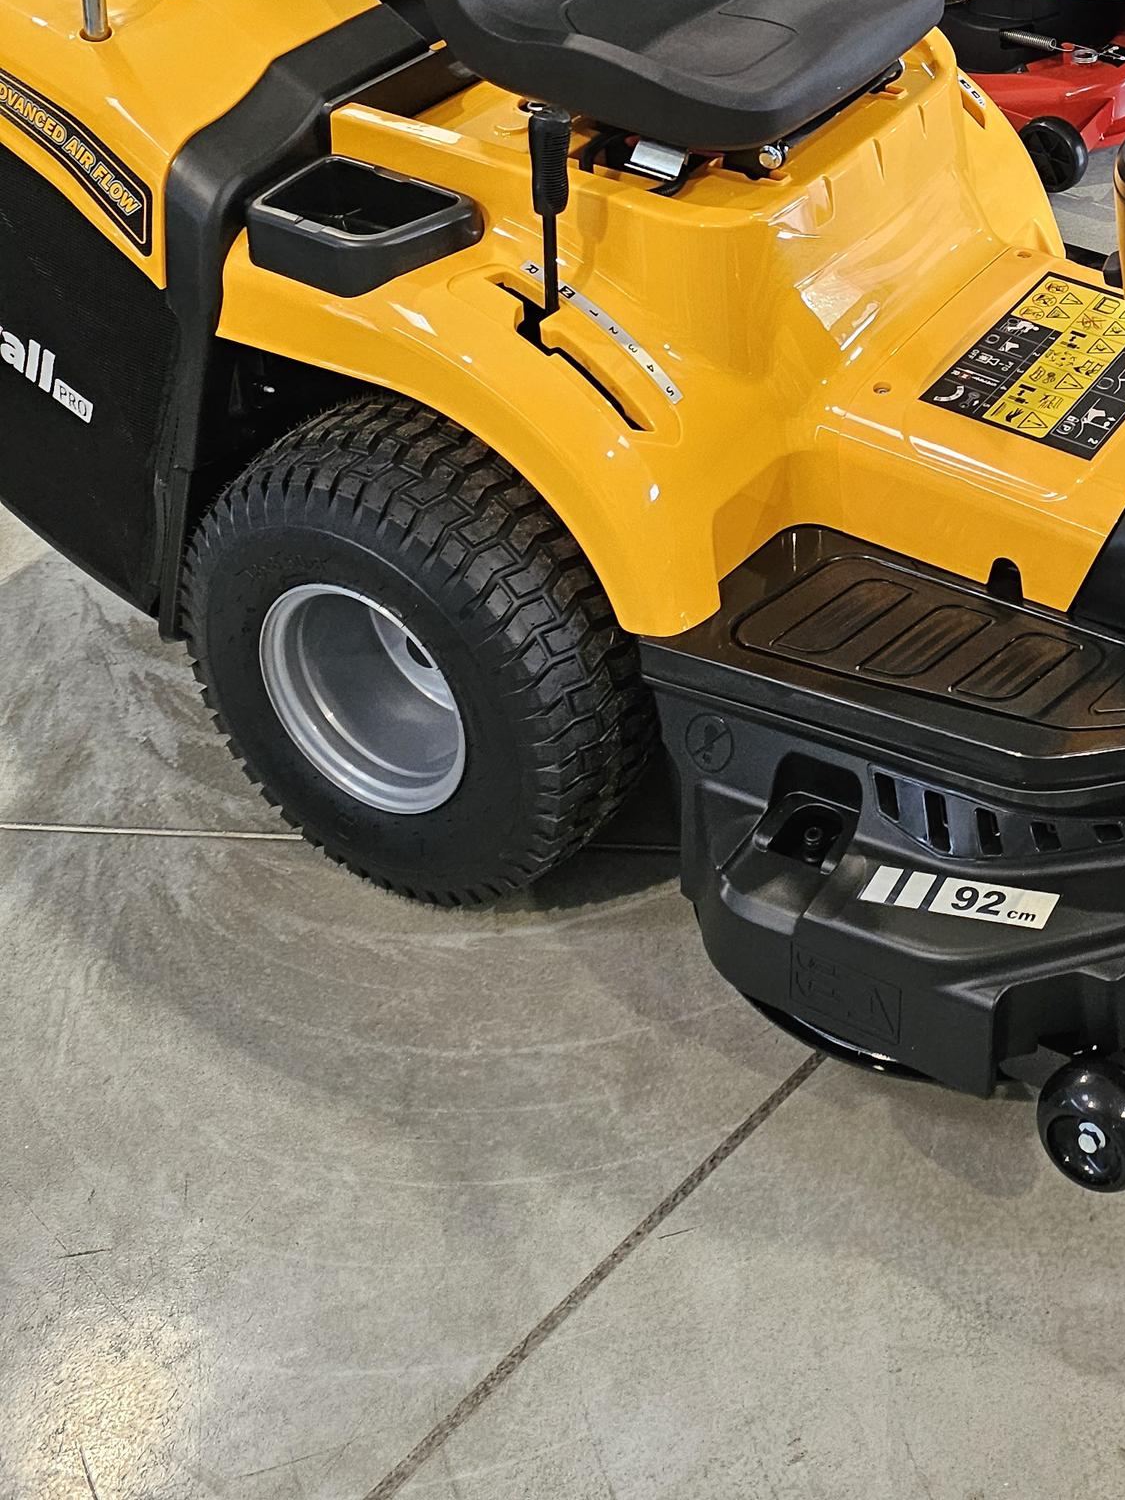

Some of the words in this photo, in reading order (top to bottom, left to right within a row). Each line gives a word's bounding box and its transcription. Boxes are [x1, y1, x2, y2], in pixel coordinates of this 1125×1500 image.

[62, 136, 97, 174] AIR
[90, 161, 142, 216] FLOW
[526, 264, 539, 274] R
[589, 309, 599, 317] 1
[609, 326, 619, 335] 2
[628, 344, 637, 353] 3
[646, 364, 655, 373] 4
[666, 386, 675, 396] 5
[58, 385, 88, 417] PRO
[950, 886, 1007, 916] 92
[1006, 910, 1037, 922] cm
